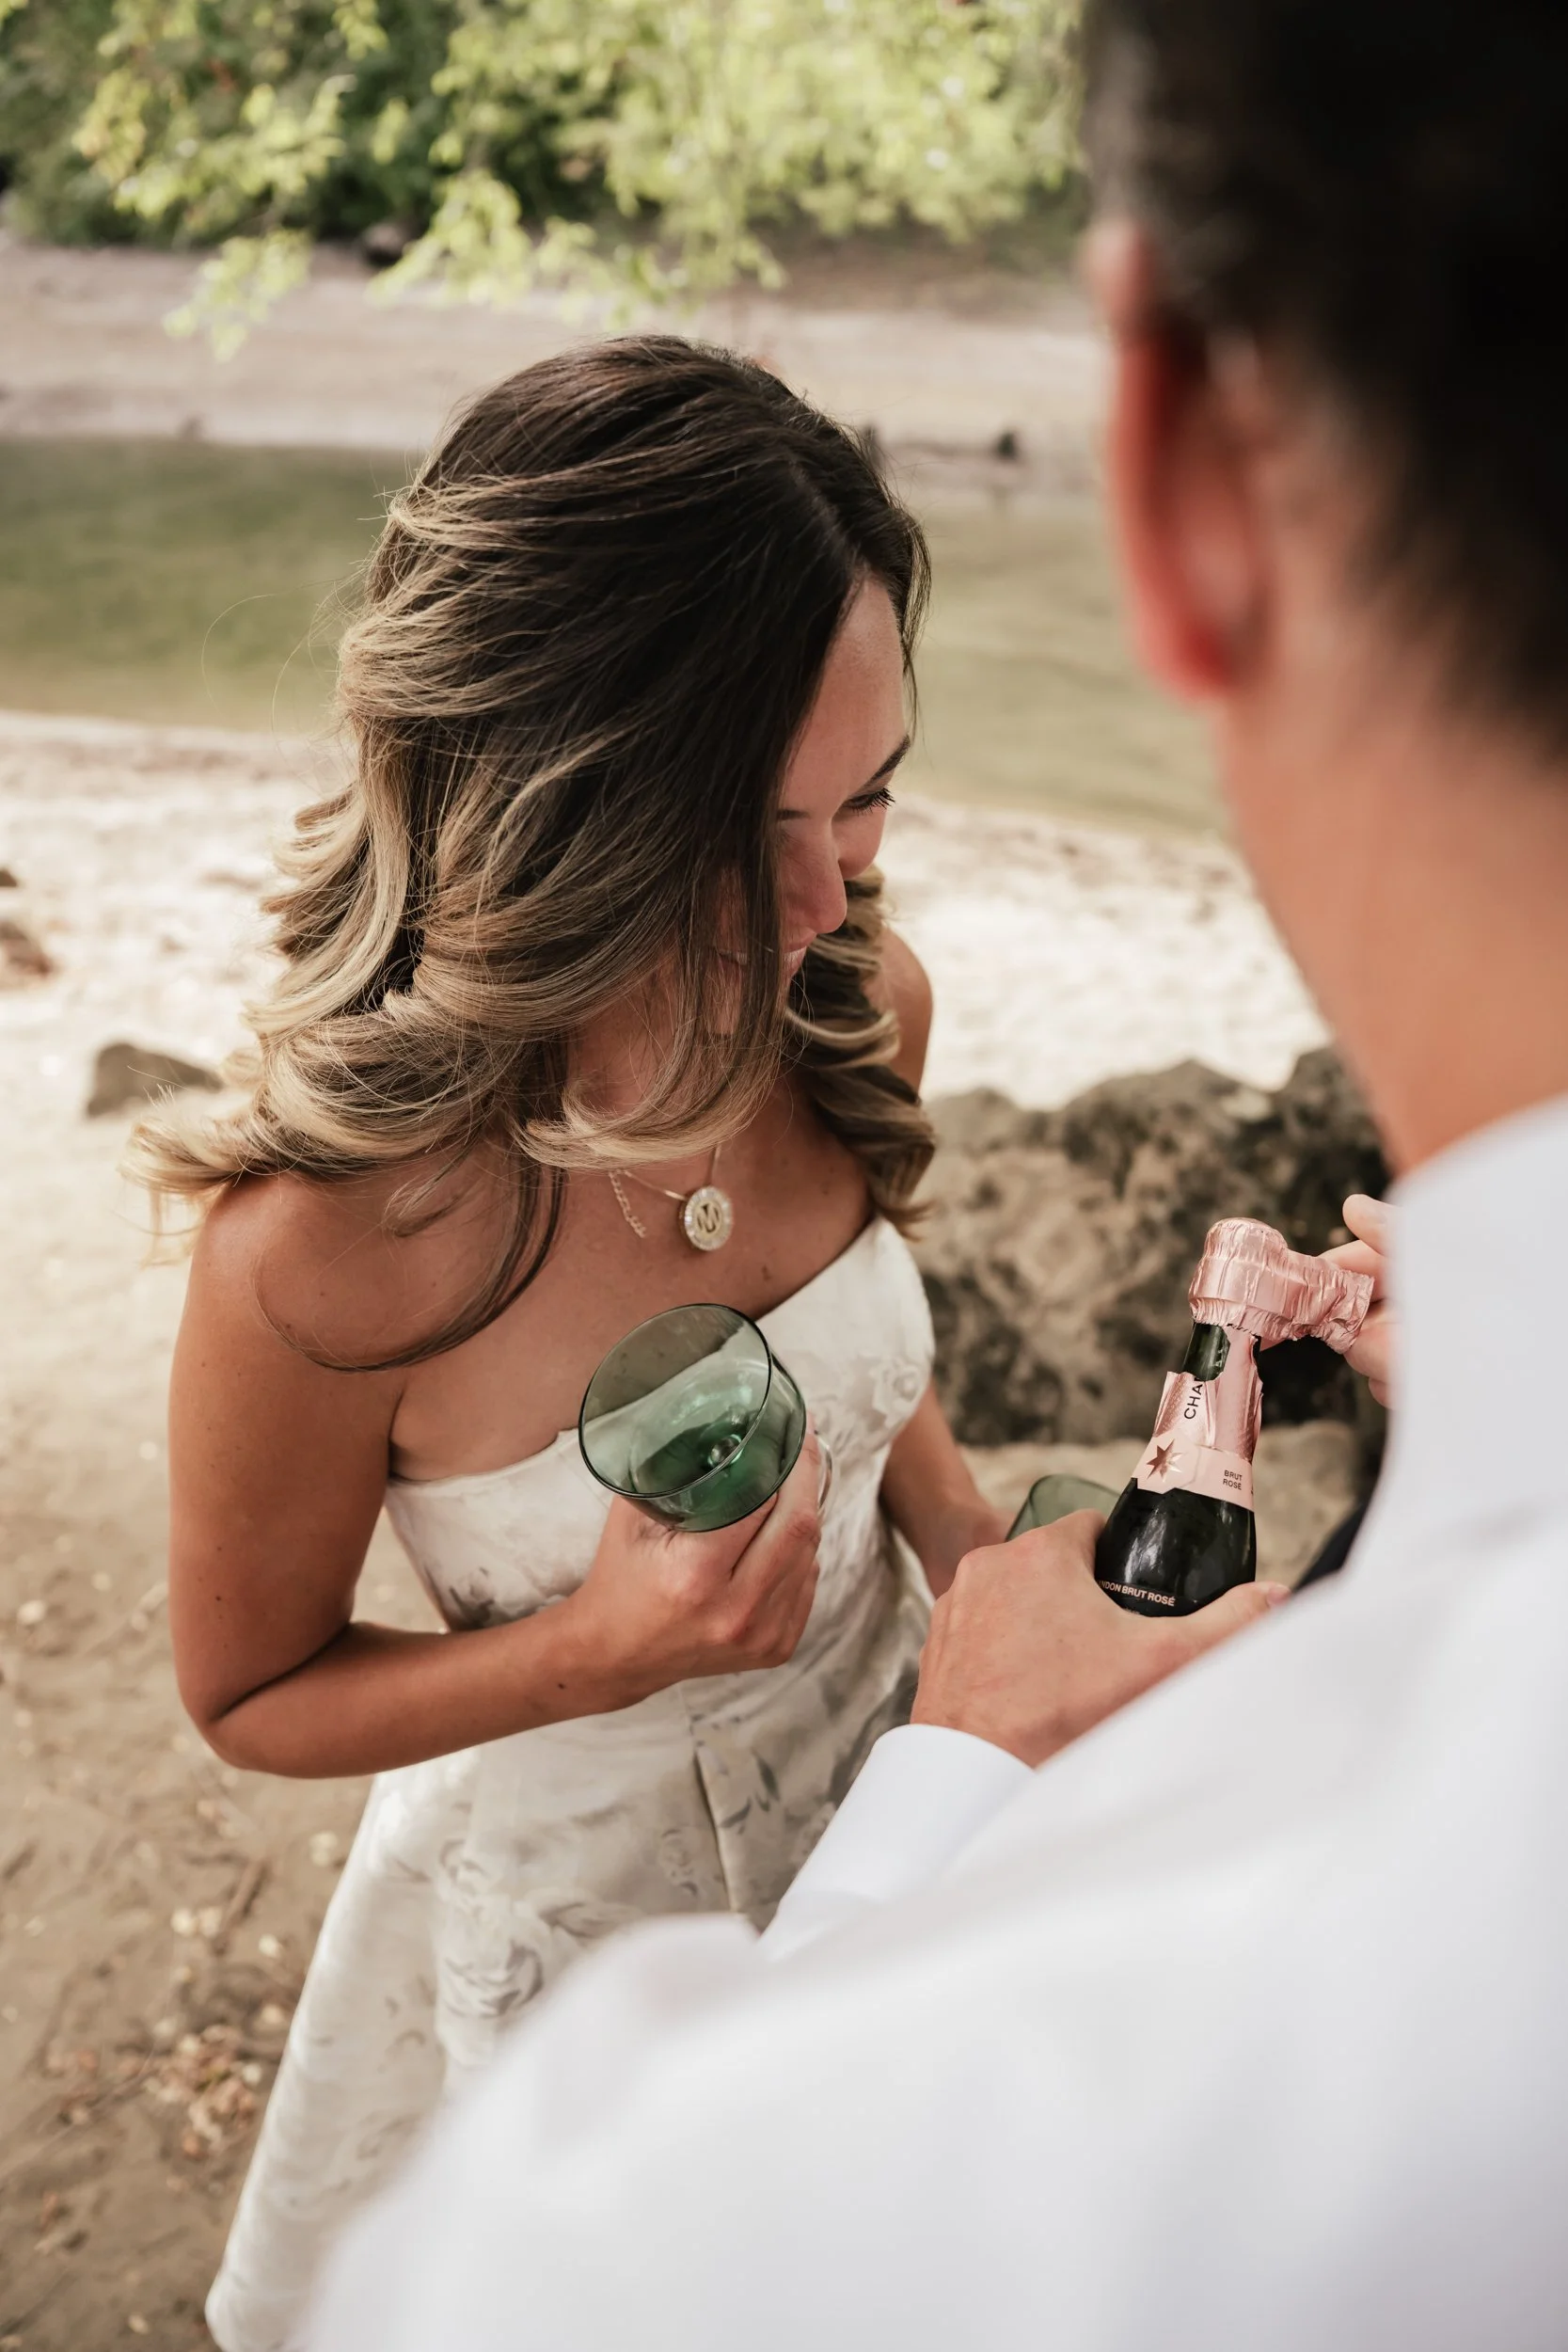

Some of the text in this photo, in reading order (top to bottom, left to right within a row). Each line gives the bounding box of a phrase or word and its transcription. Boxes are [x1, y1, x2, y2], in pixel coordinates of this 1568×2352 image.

[1184, 1376, 1205, 1420] CHA
[1224, 1470, 1243, 1482] BRUT
[1099, 1580, 1176, 1607] NDON BRUT ROSÉ
